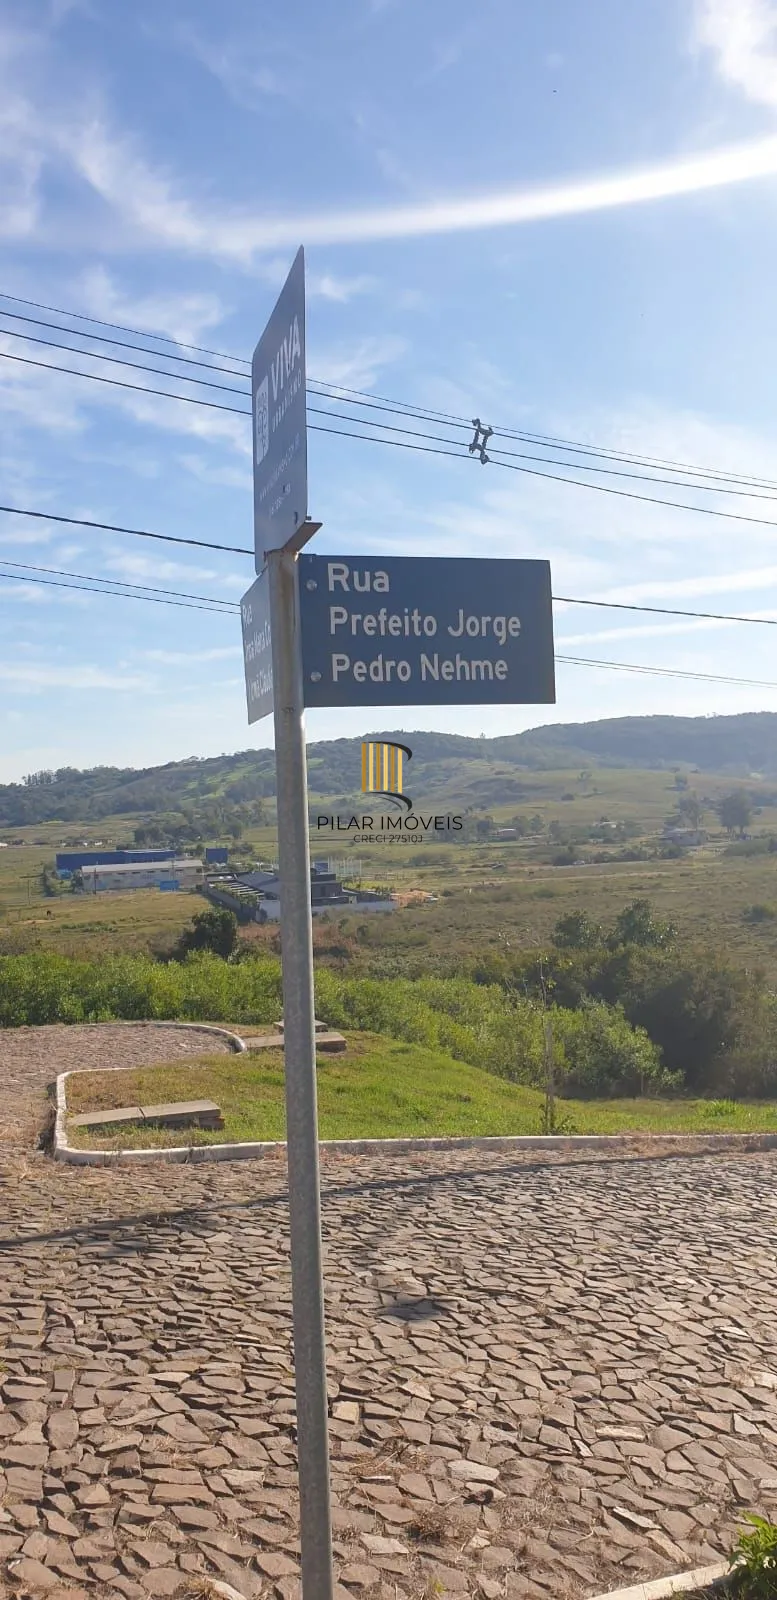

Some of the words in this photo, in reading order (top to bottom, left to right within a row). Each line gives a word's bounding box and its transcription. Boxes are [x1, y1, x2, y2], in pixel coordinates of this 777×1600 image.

[271, 315, 301, 402] VIVA
[327, 563, 390, 593] Rua
[329, 606, 437, 638] Prefeito
[447, 608, 521, 646] Jorge
[332, 653, 412, 683] Pedro
[420, 653, 509, 682] Nehme
